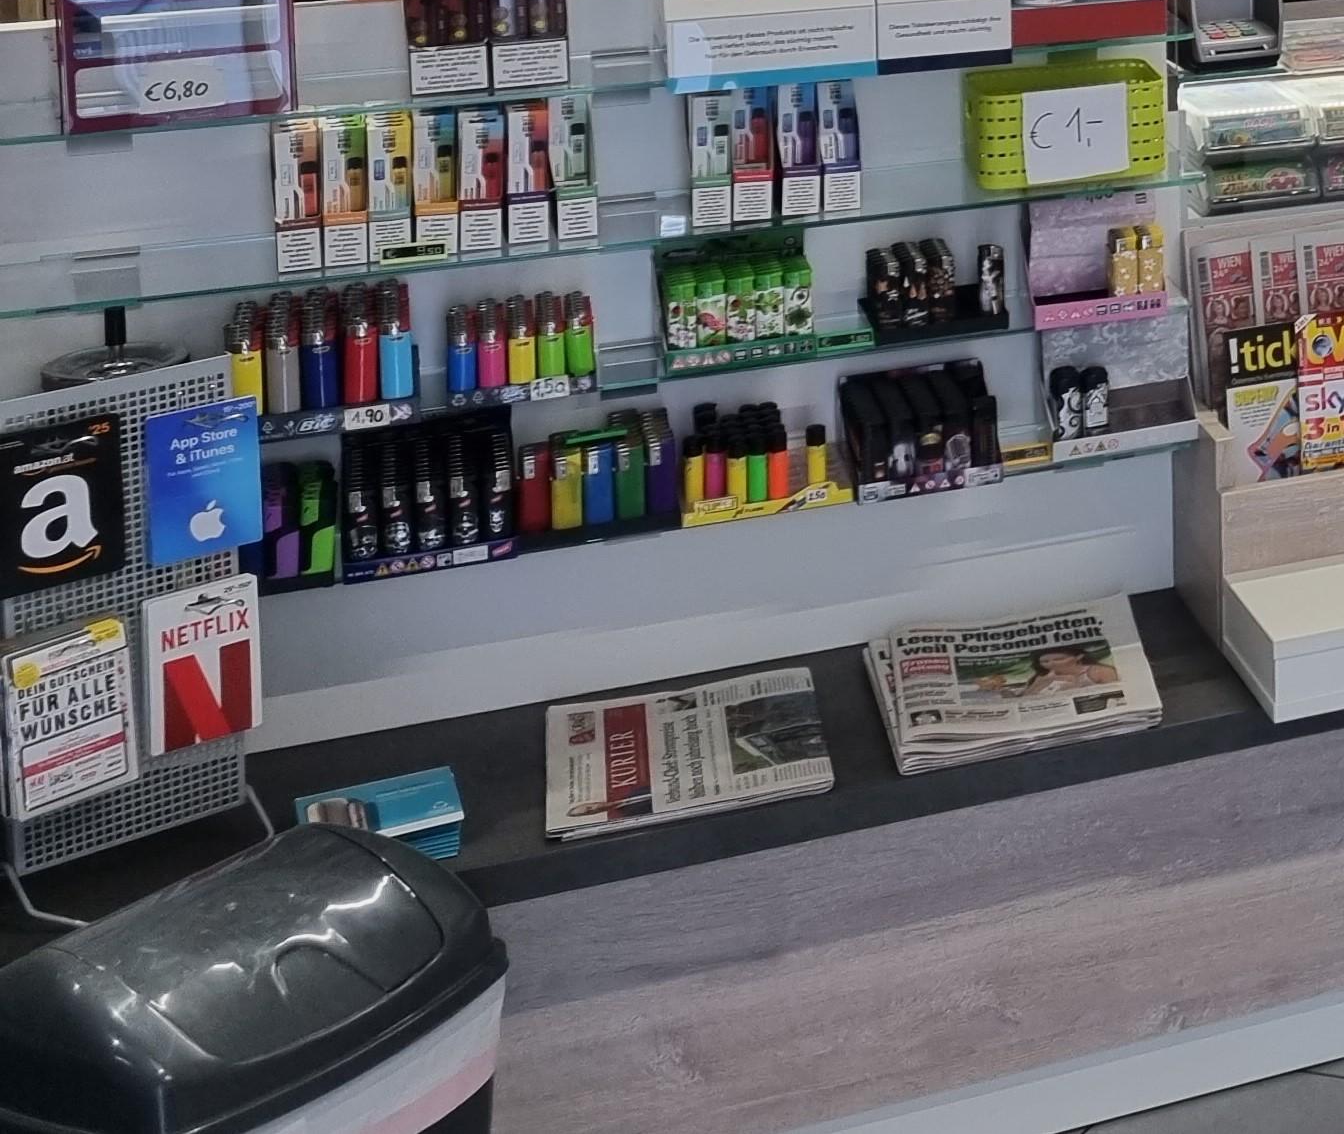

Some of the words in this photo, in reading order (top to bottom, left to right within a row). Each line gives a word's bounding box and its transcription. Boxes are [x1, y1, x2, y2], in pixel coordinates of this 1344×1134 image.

[144, 80, 209, 102] €6,80
[170, 434, 198, 452] App
[201, 427, 238, 445] Store
[190, 443, 235, 463] iTunes
[13, 453, 75, 475] amazon.at
[20, 474, 98, 559] a
[160, 609, 249, 652] NETFLIX
[896, 630, 957, 648] Leere
[961, 615, 1104, 644] Pflegebetten,
[903, 641, 949, 657] weil
[953, 633, 1047, 655] Personal
[1054, 626, 1103, 646] fehlt
[17, 680, 47, 700] DEIN
[50, 657, 116, 689] GUTSCHEIN
[67, 673, 116, 704] ALLE
[608, 729, 636, 788] KURIER
